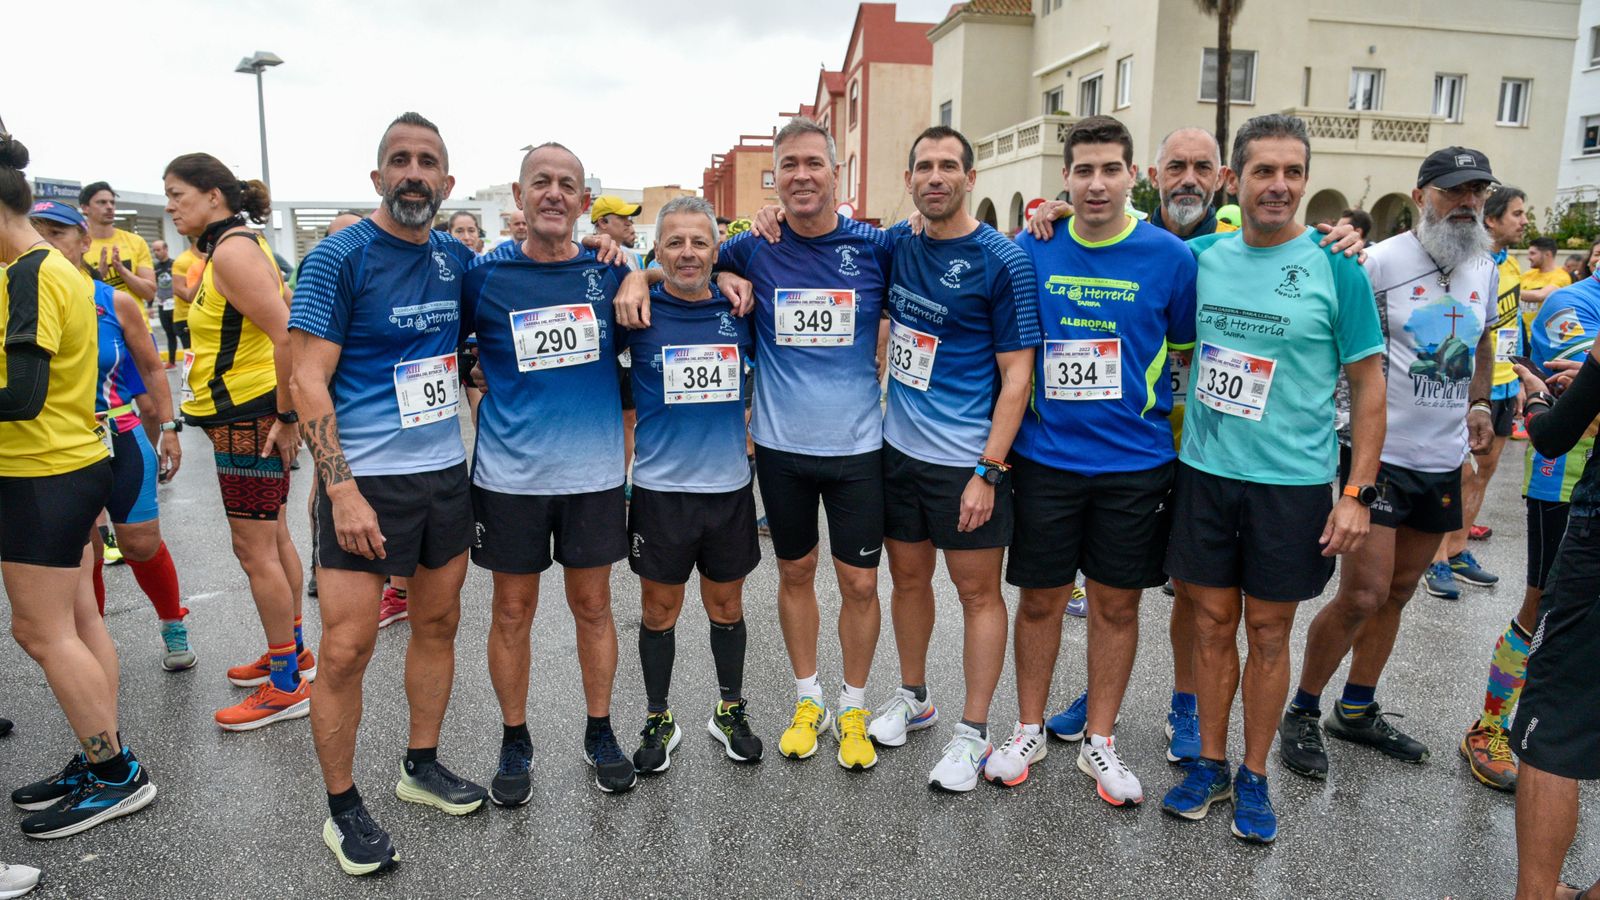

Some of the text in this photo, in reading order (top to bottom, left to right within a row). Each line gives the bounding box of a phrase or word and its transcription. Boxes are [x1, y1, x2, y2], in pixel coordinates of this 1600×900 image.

[1281, 264, 1310, 277] BRIGADA
[1050, 284, 1135, 302] La Herrería
[1274, 288, 1301, 298] EMPUJE
[793, 310, 832, 332] 349
[1060, 317, 1117, 329] ALBROPAN
[1199, 314, 1284, 337] La Herrería
[534, 327, 577, 355] 290
[683, 365, 722, 389] 384
[1058, 362, 1098, 385] 334
[1207, 368, 1243, 399] 330
[424, 379, 446, 407] 95
[1412, 374, 1441, 399] Vive
[1442, 376, 1452, 400] la
